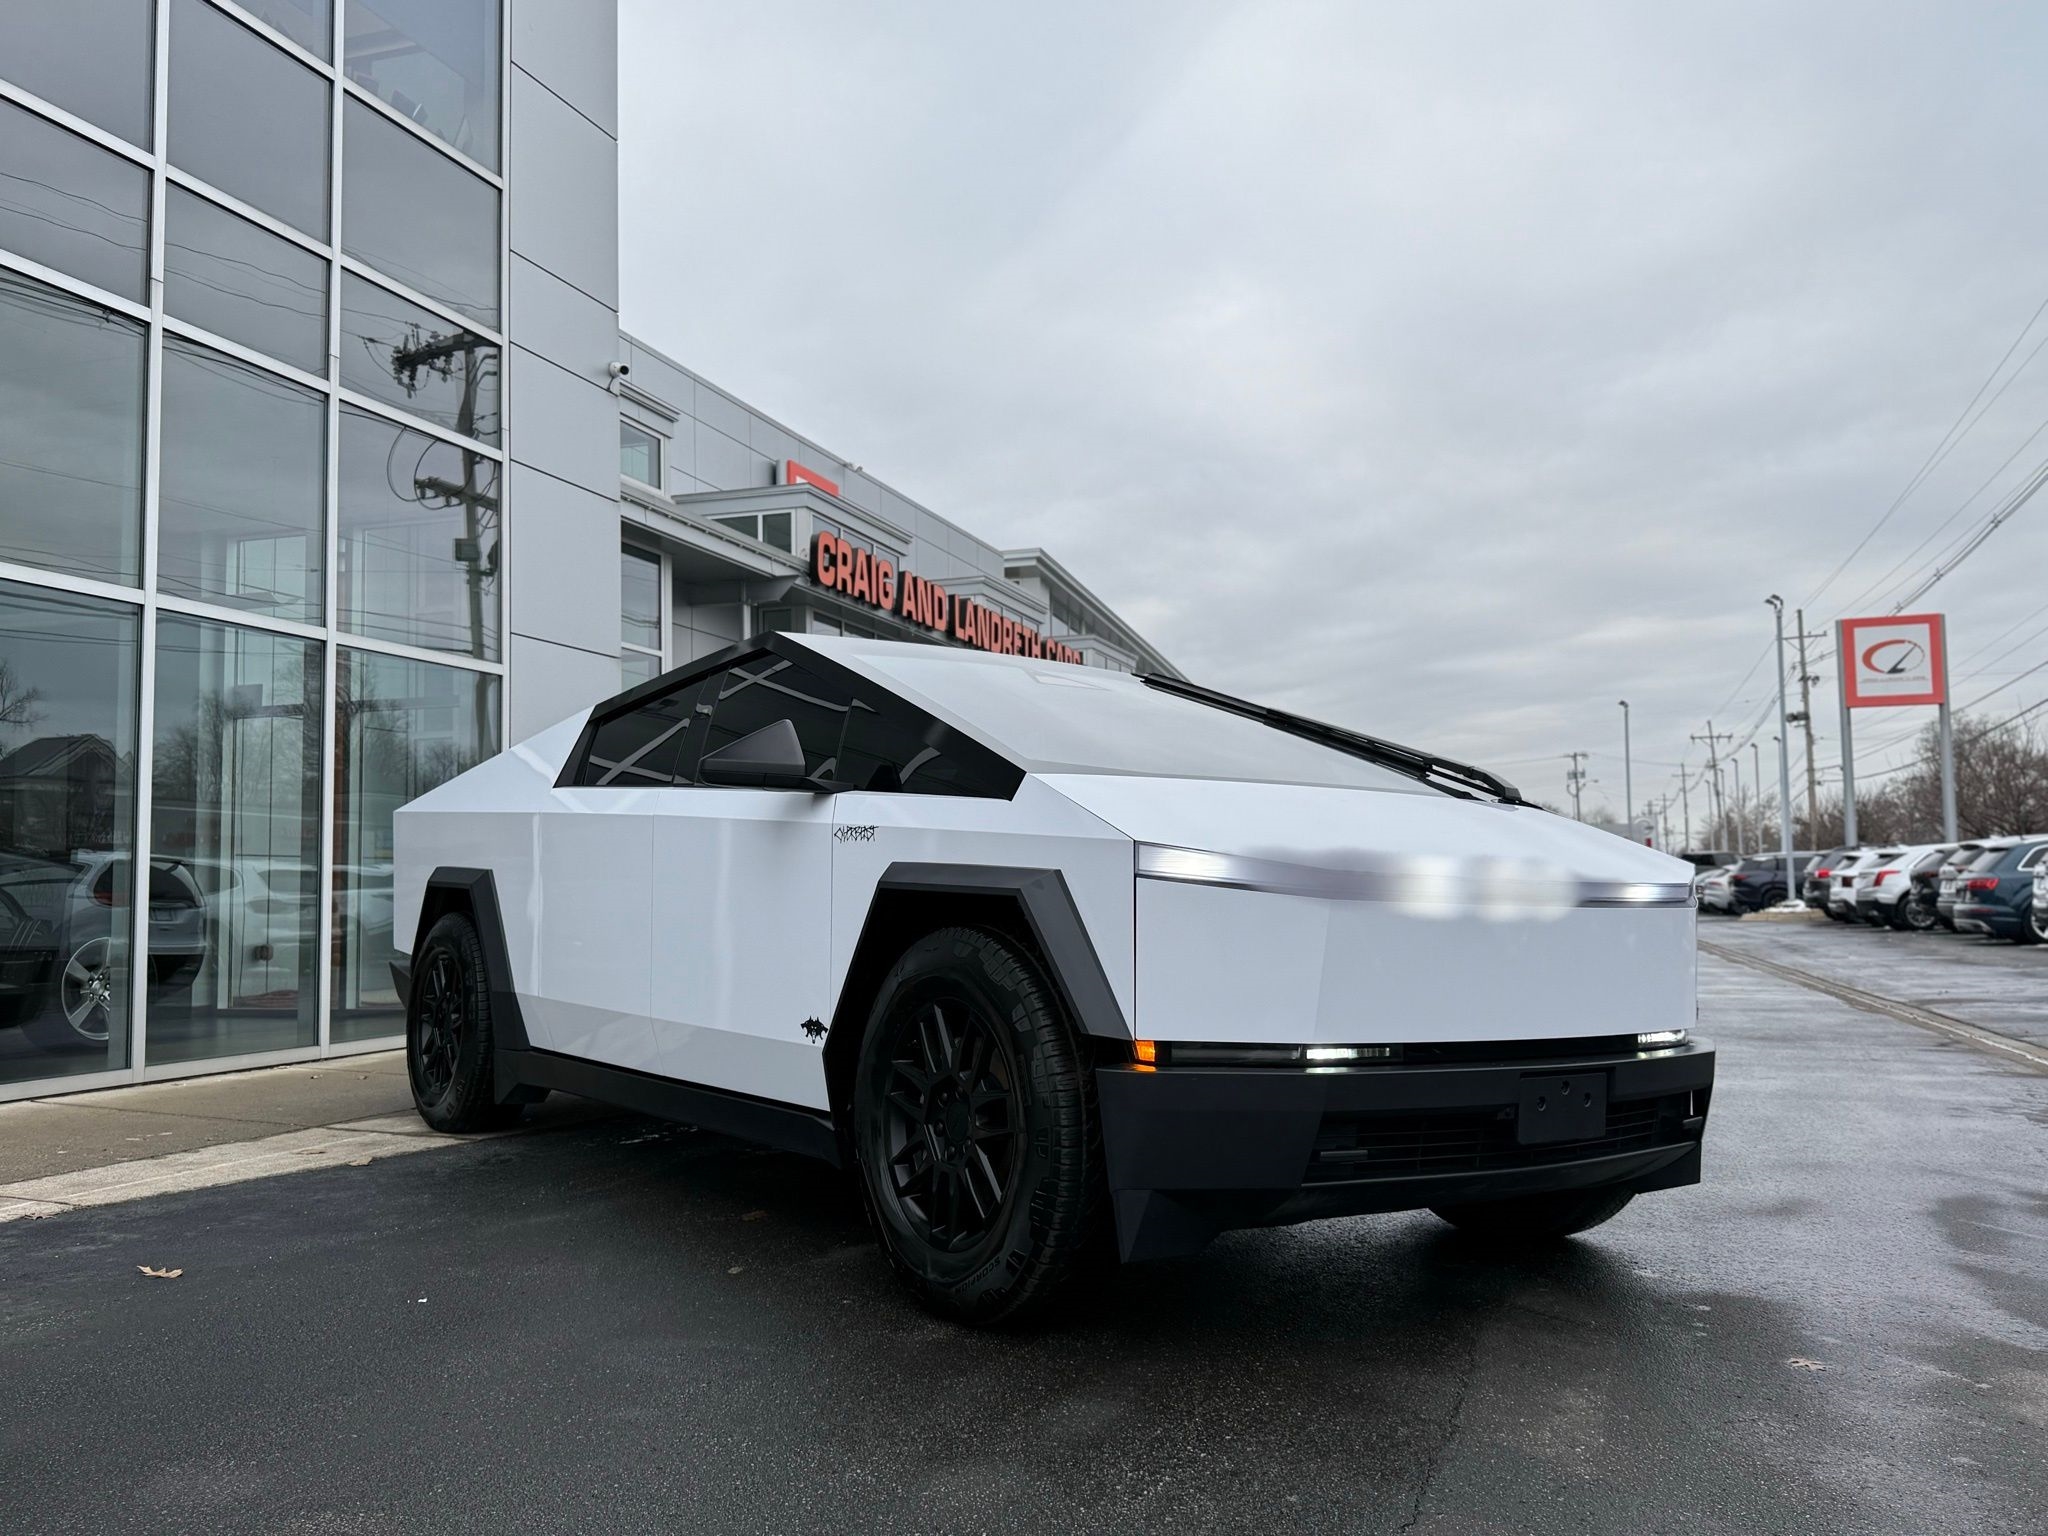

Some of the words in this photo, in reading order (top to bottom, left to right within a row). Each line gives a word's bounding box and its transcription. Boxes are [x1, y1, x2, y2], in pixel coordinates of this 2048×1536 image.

[817, 530, 895, 611] CRAIG
[902, 570, 948, 632] AND
[955, 594, 1042, 660] LANDRETH
